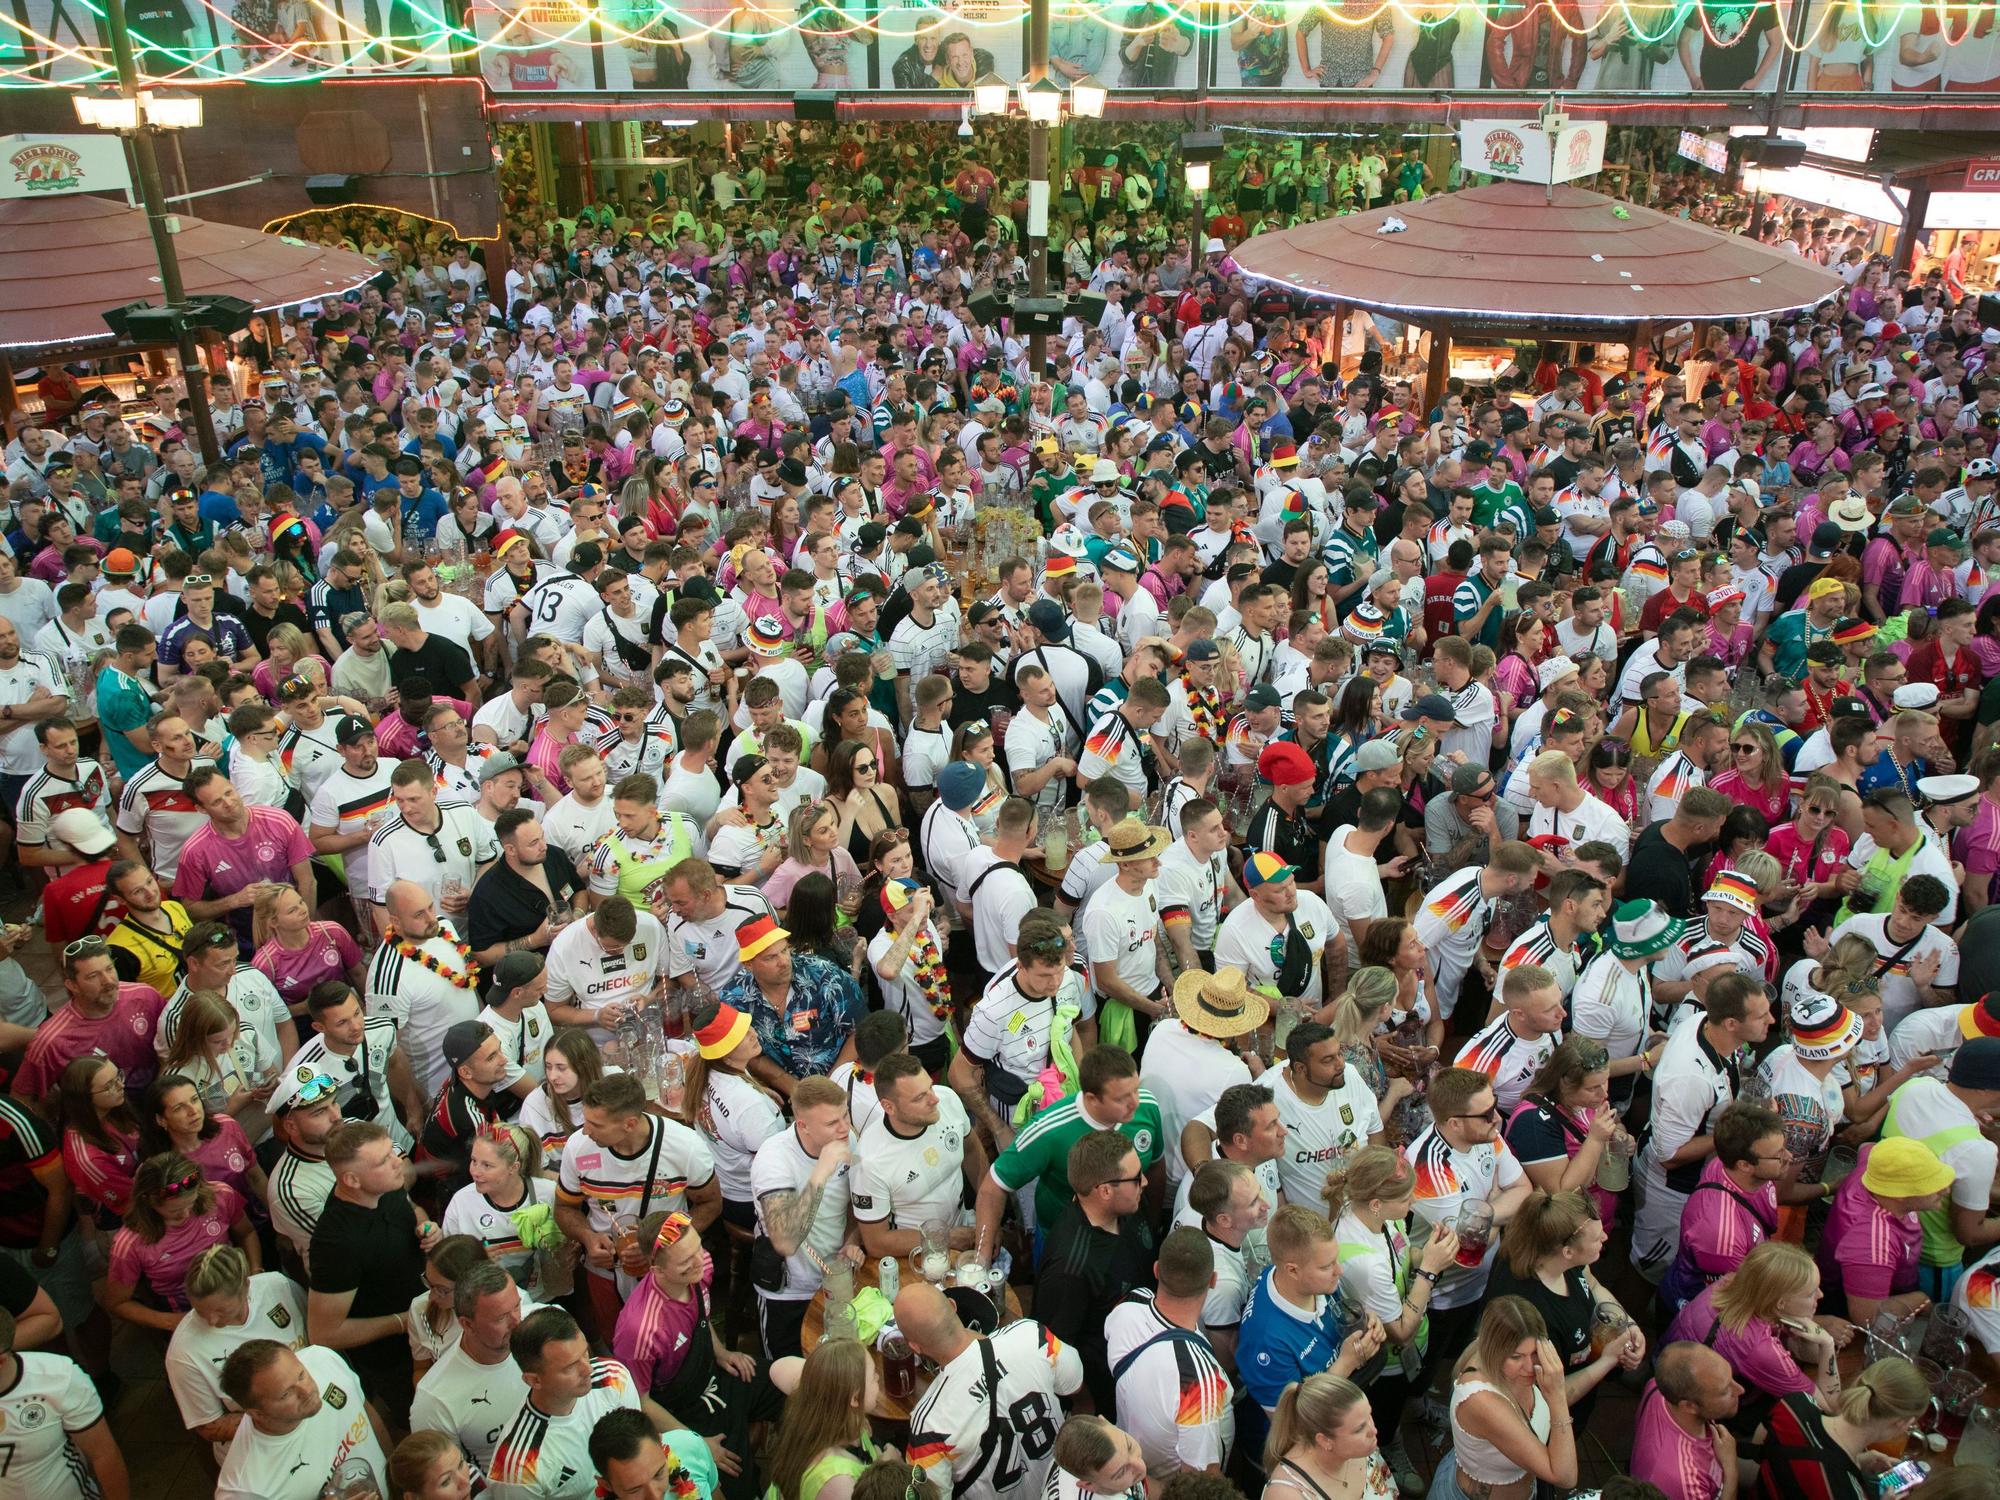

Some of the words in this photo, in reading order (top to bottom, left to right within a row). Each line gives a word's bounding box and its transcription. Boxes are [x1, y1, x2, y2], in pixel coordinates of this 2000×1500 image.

[963, 12, 988, 20] MILSKI
[1486, 131, 1522, 150] BIERKÖNIG
[14, 146, 77, 166] BIERKÖNIG
[537, 588, 563, 623] 13
[1427, 595, 1454, 605] BIERK
[353, 719, 364, 731] A
[587, 971, 649, 995] CHECK24
[991, 1391, 1060, 1494] 28
